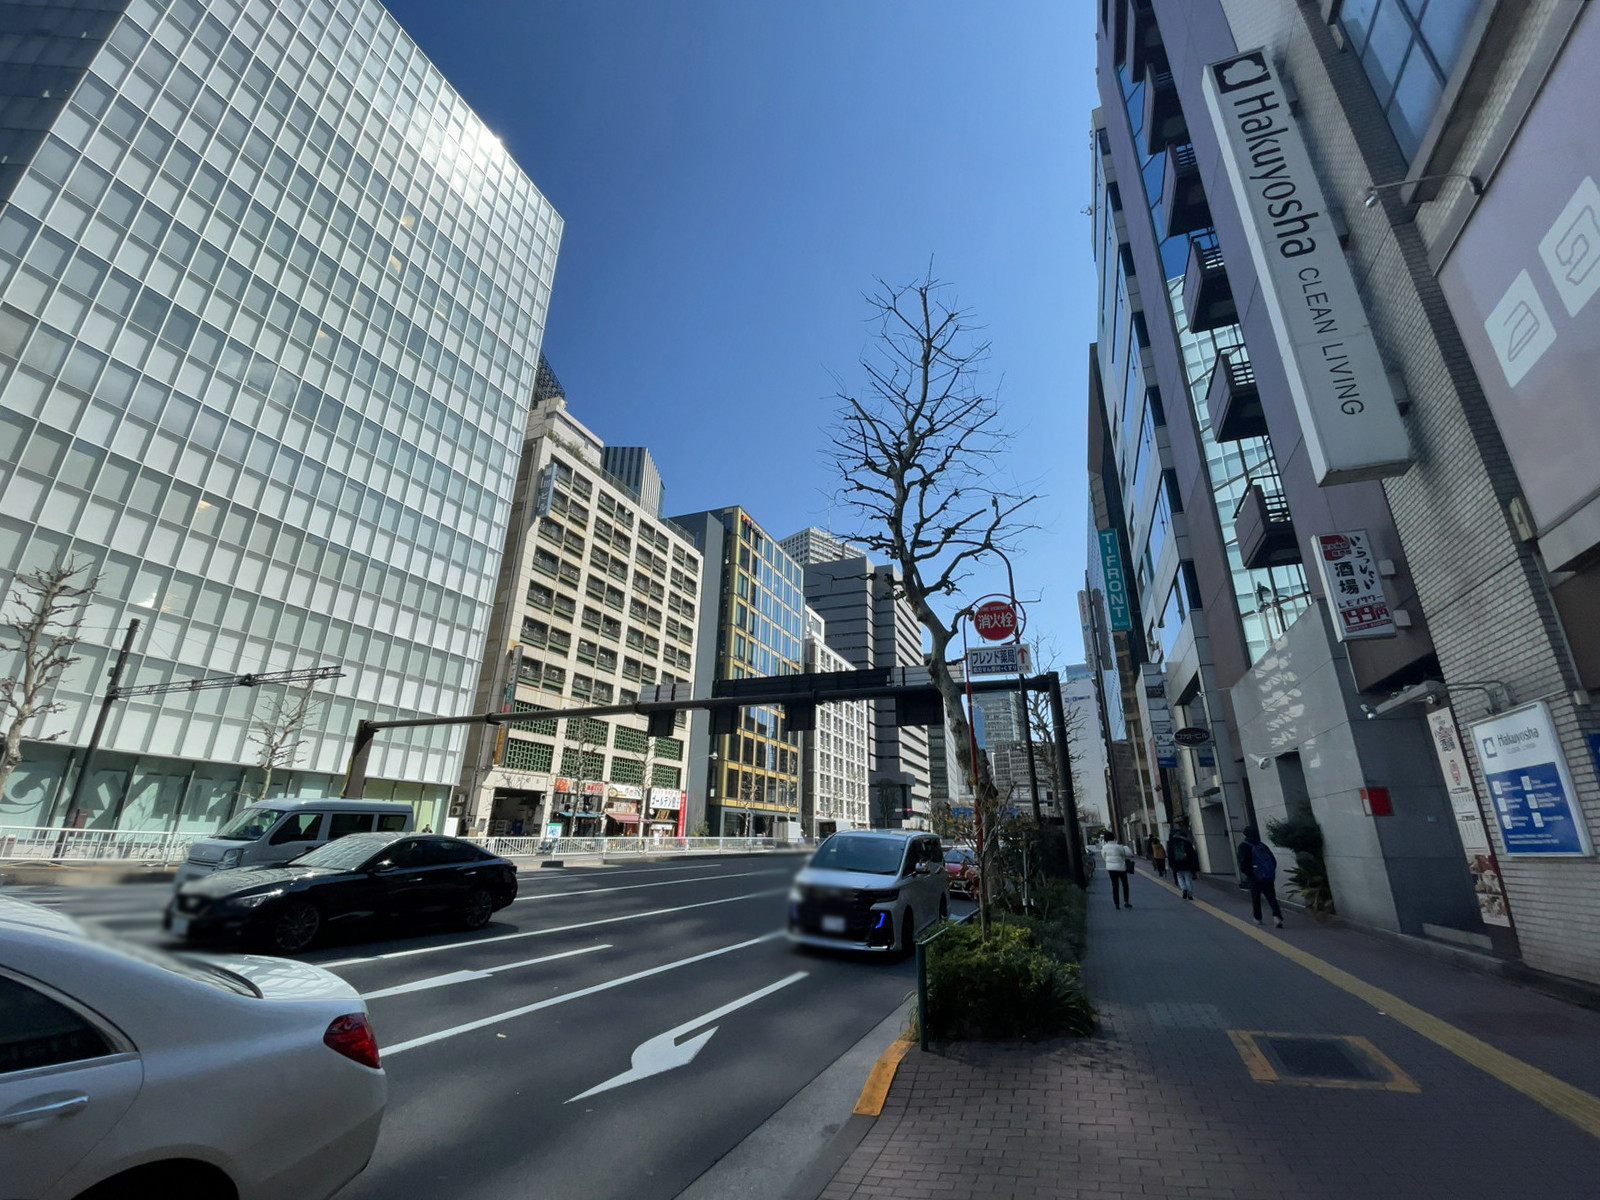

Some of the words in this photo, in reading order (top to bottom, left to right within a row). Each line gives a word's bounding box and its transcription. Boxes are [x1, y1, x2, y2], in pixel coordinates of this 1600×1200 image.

[1234, 90, 1319, 258] Hakuyosha
[1298, 267, 1338, 335] CLEAN
[1322, 342, 1364, 416] LIVING
[1102, 532, 1125, 618] TIFRONT
[1334, 562, 1359, 594] 酒場
[1350, 536, 1374, 589] いらっしゃい
[978, 612, 1014, 629] 消火栓
[972, 649, 1015, 665] フレンド薬局
